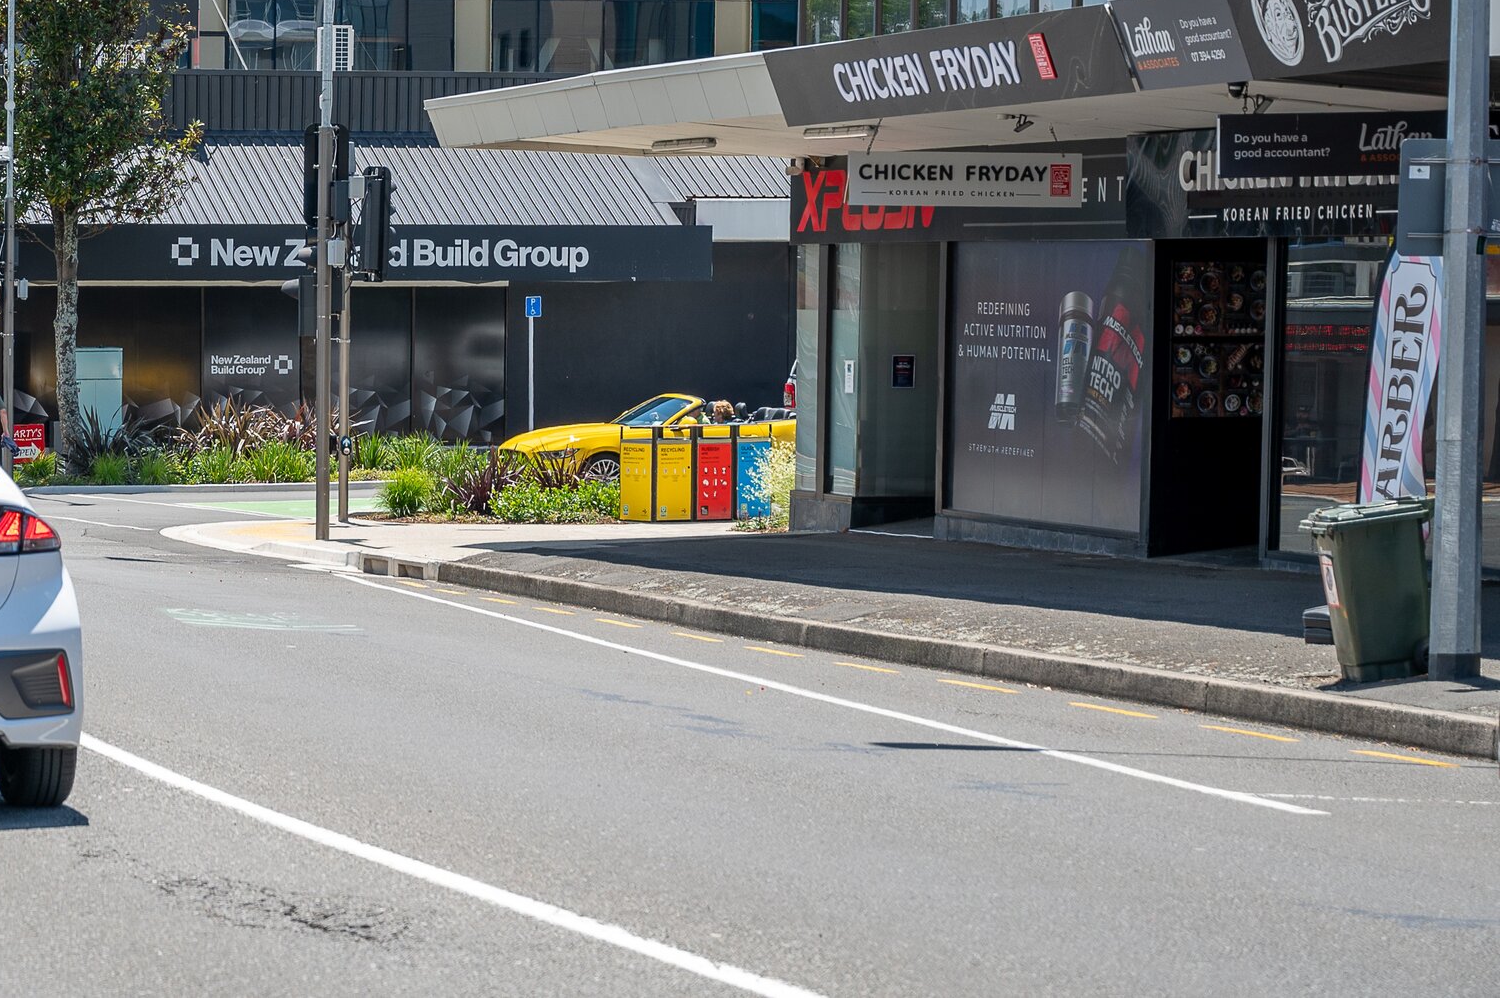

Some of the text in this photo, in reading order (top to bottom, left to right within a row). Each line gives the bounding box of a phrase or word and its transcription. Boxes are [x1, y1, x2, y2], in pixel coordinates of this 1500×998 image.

[1179, 19, 1188, 29] Do
[1189, 19, 1199, 30] you
[1198, 16, 1212, 27] have
[1123, 16, 1175, 58] Lathan
[1185, 28, 1233, 45] good accountant?
[1142, 57, 1180, 70] ASSOCIATES
[1190, 51, 1200, 62] 07
[1200, 50, 1211, 62] 394
[833, 53, 930, 103] CHICKEN
[929, 40, 1021, 93] FRYDAY
[1234, 133, 1307, 145] Do you have a
[1234, 147, 1330, 160] good accountant?
[858, 163, 953, 181] CHICKEN
[966, 164, 1048, 182] FRYDAY
[889, 190, 1015, 198] KOREAN FRIED CHICKEN
[1223, 204, 1373, 222] KOREAN FRIED CHICKEN
[210, 239, 280, 267] New
[413, 239, 489, 267] Build
[494, 239, 589, 273] Group
[977, 302, 1030, 316] REDEFINING
[964, 323, 994, 337] ACTIVE
[997, 324, 1046, 339] NUTRITION
[1103, 316, 1144, 369] MUSCLETECH
[211, 355, 271, 364] New Zealand
[958, 344, 1051, 362] & HUMAN POTENTIAL
[211, 365, 265, 376] Build Group
[1092, 356, 1121, 390] NITRO
[1089, 372, 1114, 403] TECH
[989, 404, 1016, 413] MUSCLETECH
[19, 448, 36, 456] PEN
